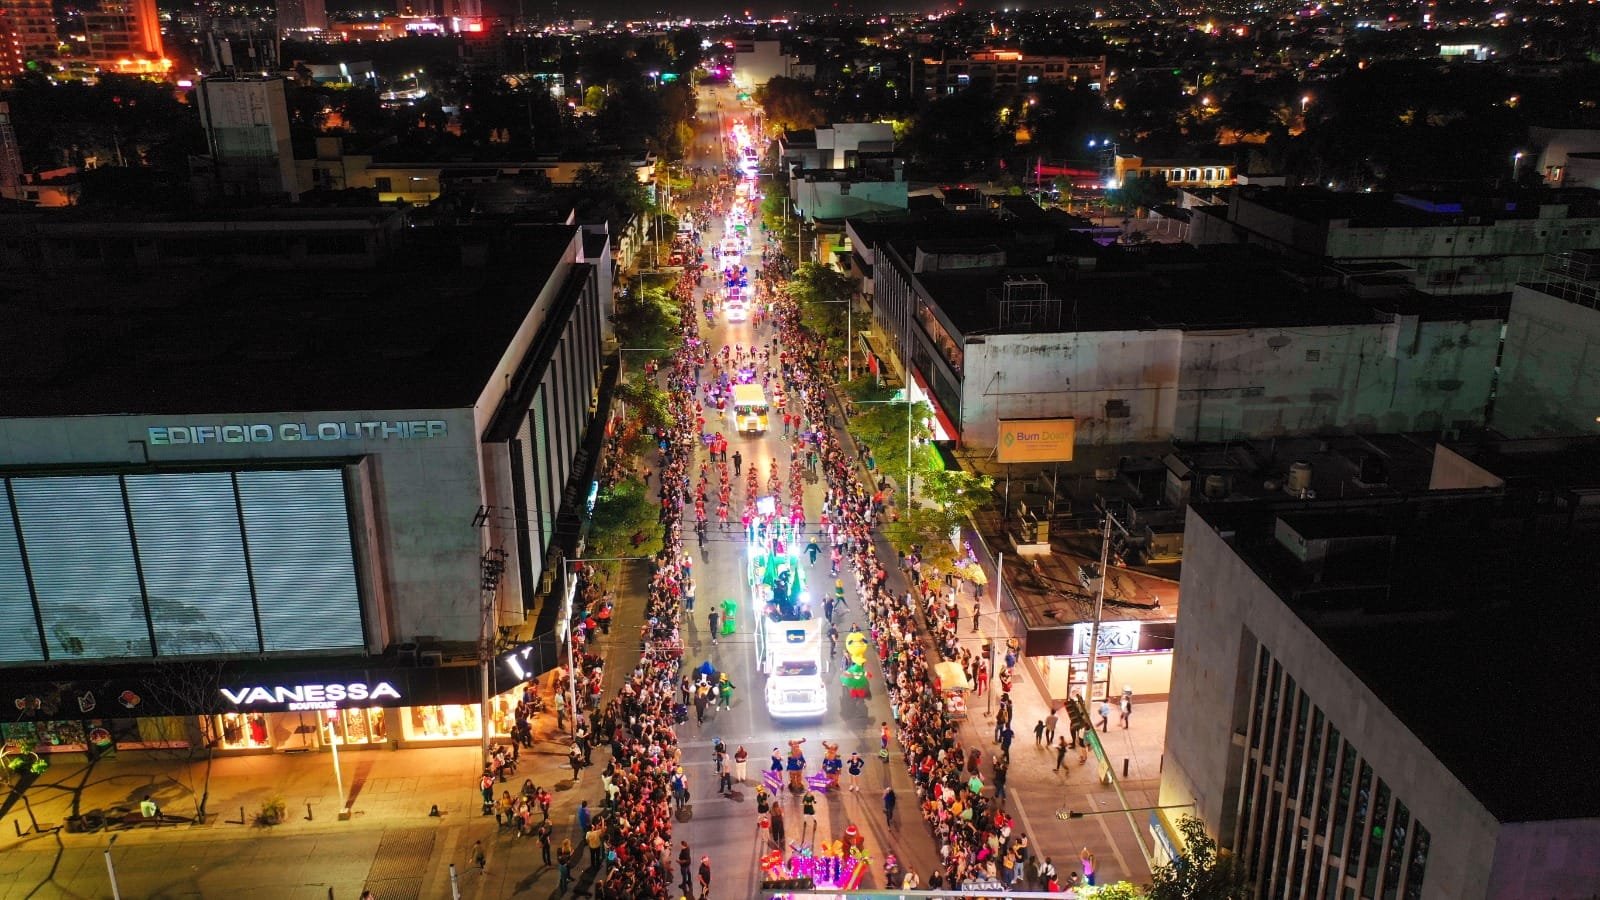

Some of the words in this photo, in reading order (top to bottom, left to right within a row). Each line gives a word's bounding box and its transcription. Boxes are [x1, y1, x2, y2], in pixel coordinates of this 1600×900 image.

[148, 425, 273, 445] EDIFICIO
[279, 420, 448, 441] CLOUTHIER
[219, 681, 402, 705] VANESSA
[288, 701, 338, 711] BOUTIQUE
